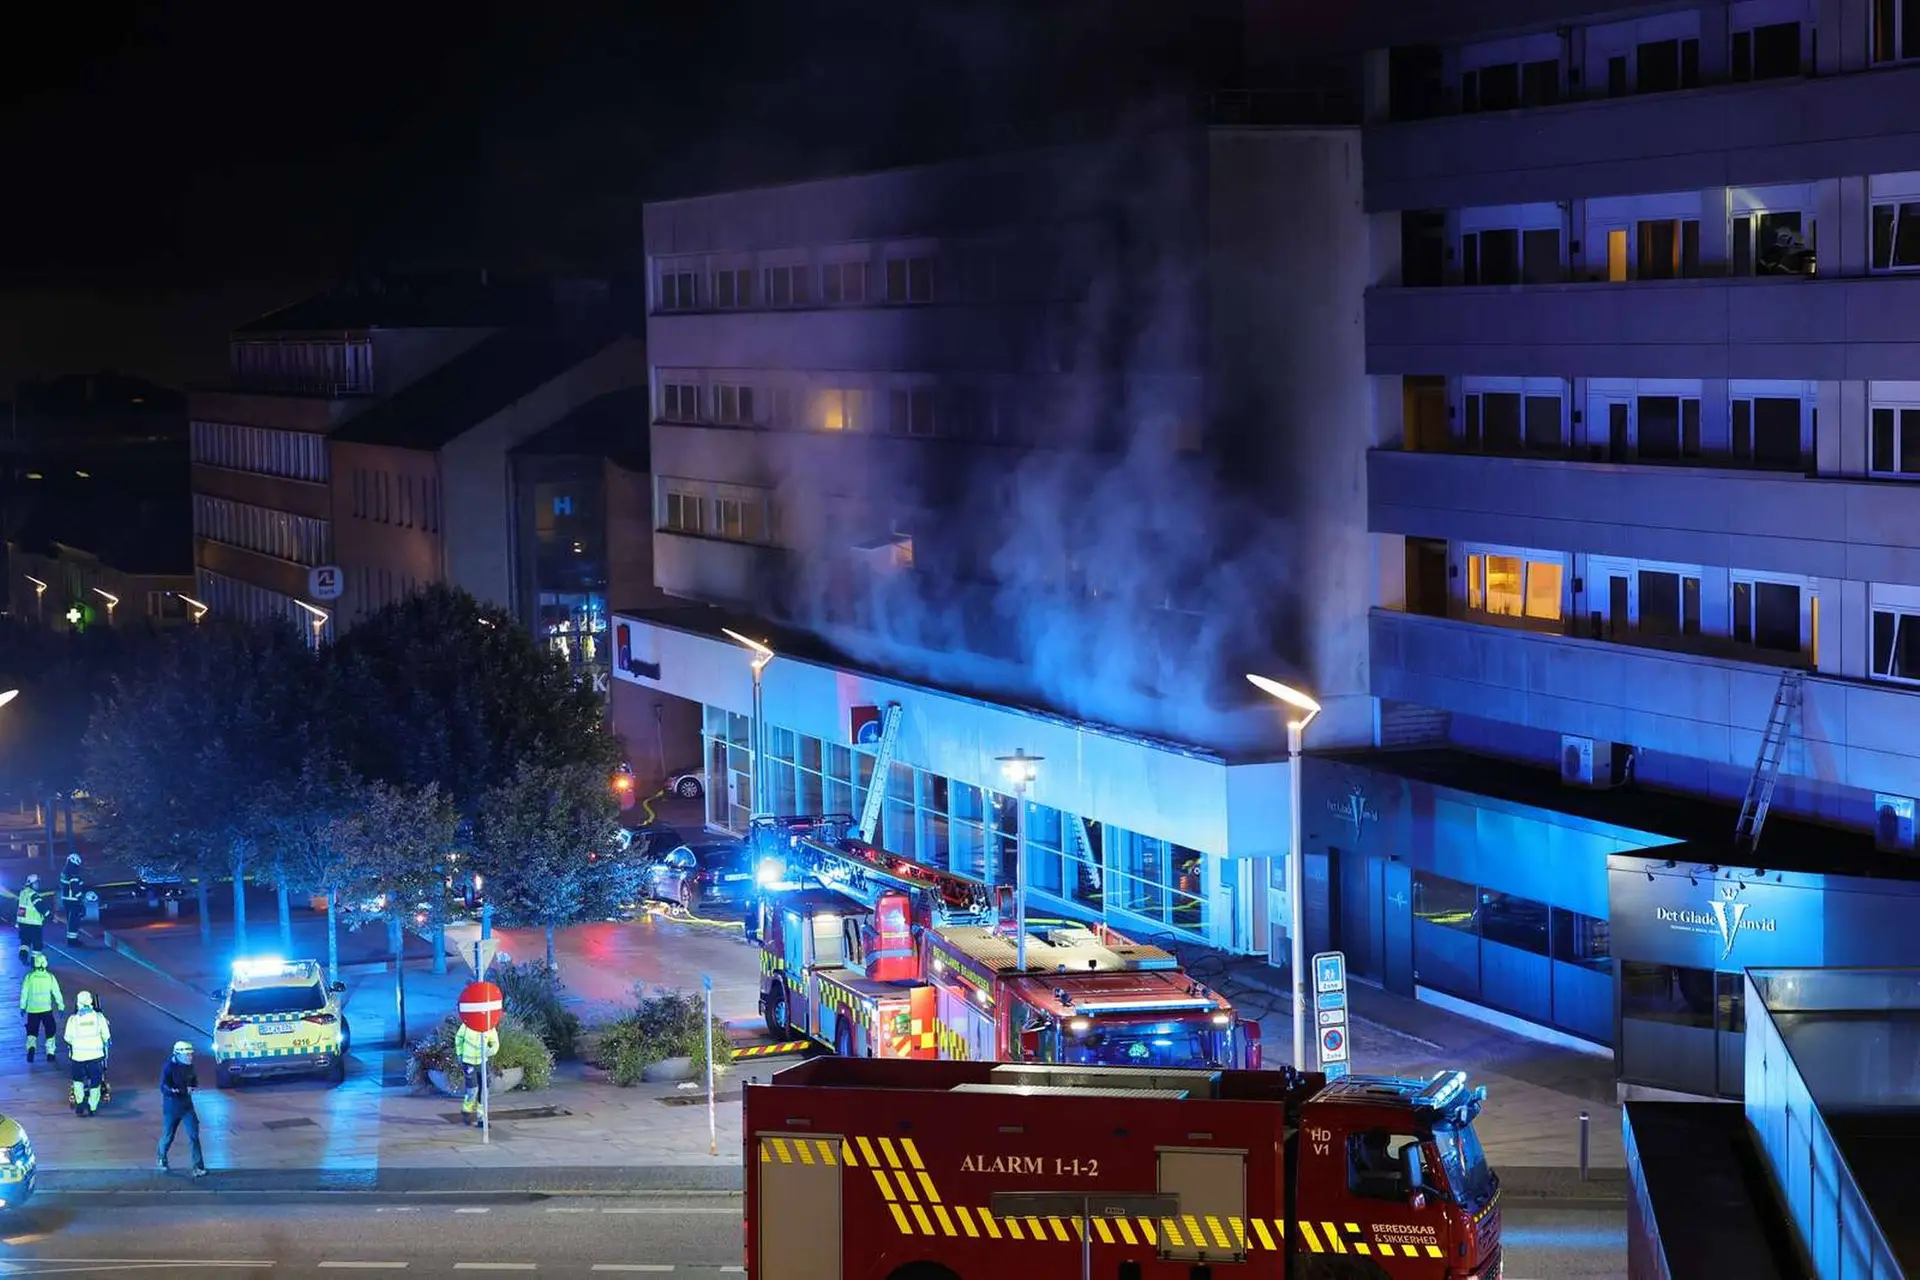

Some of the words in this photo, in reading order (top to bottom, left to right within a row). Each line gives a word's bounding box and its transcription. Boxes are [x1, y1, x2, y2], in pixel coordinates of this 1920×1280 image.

[1656, 907, 1678, 922] Det
[1680, 910, 1717, 926] Glade
[1311, 1127, 1331, 1142] HD
[1313, 1143, 1329, 1156] V1
[960, 1154, 1044, 1175] ALARM
[1055, 1157, 1099, 1177] 1-1-2
[1371, 1223, 1435, 1235] BEREDSKAB
[1374, 1234, 1382, 1243] &
[1383, 1234, 1437, 1245] SIKKERHED
